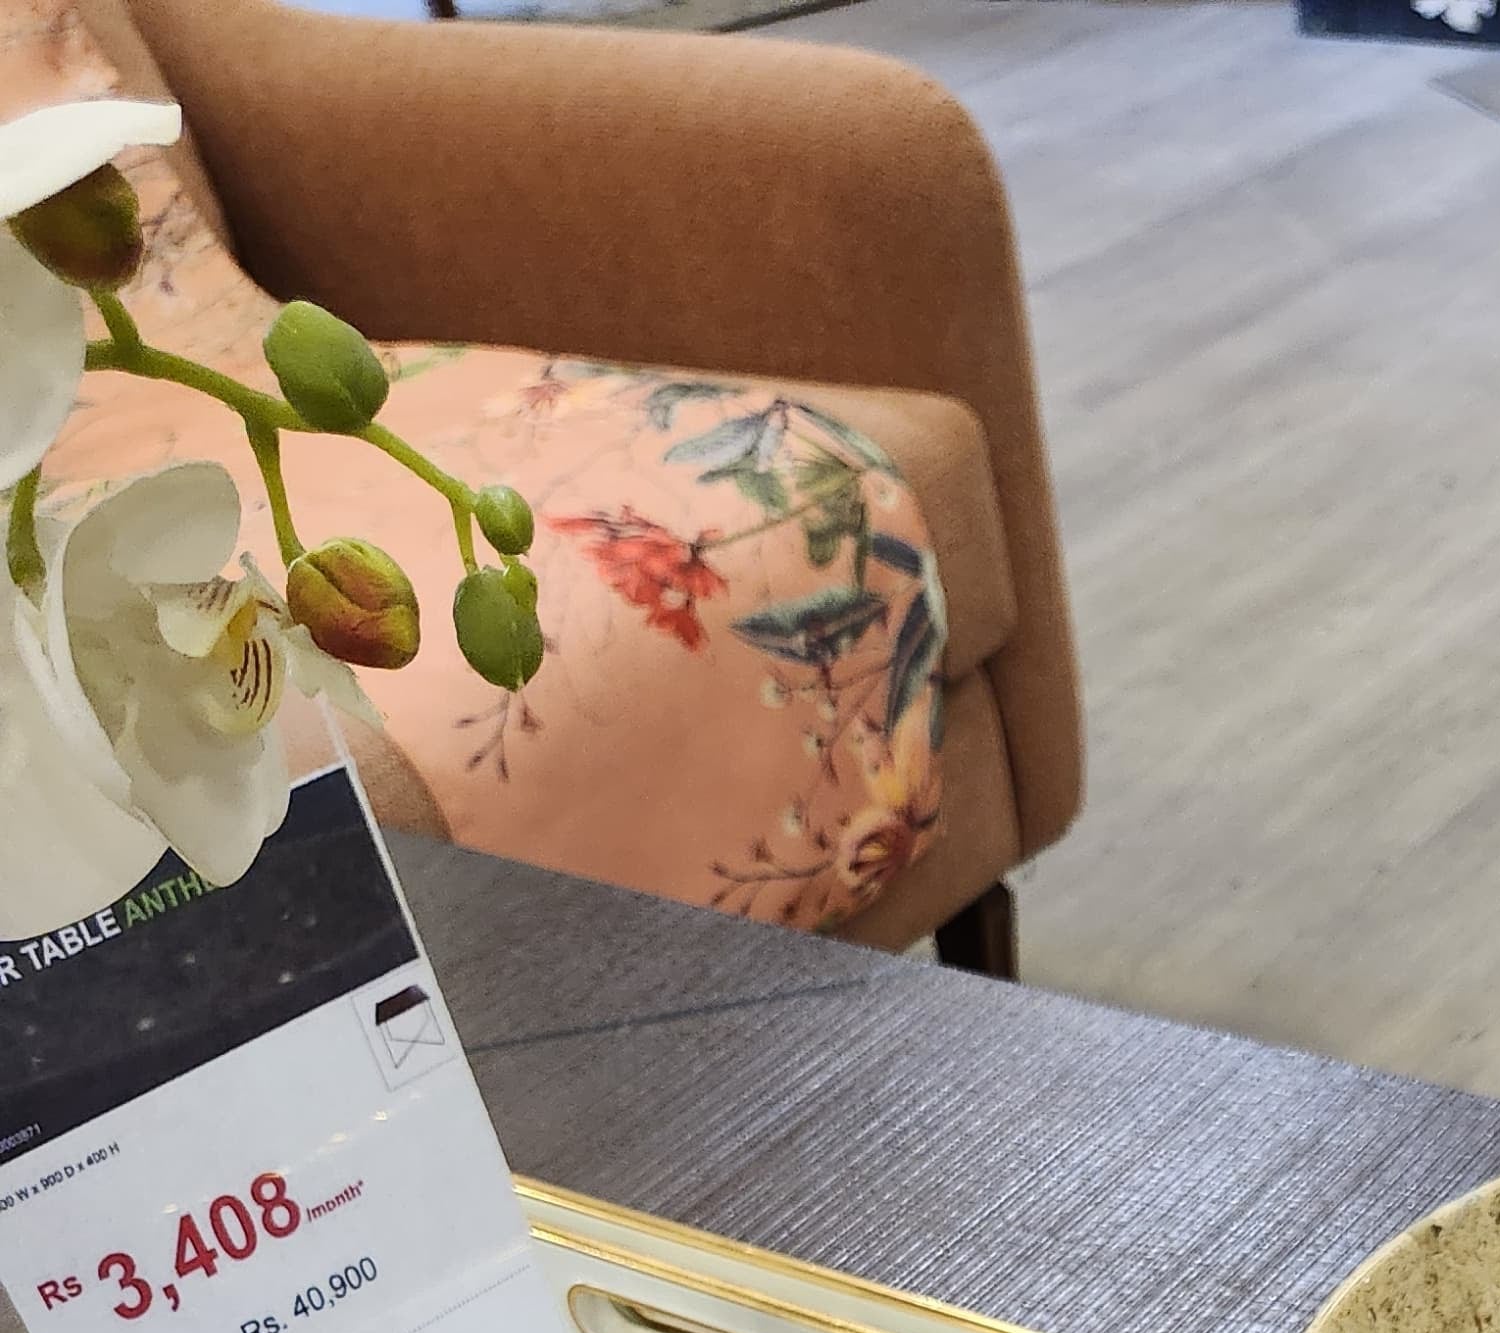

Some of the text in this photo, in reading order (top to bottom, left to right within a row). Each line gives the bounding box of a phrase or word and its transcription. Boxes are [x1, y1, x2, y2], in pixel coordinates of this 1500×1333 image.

[19, 907, 123, 971] TABLE
[15, 1187, 29, 1202] W
[63, 1165, 75, 1179] D
[109, 1141, 120, 1155] H
[37, 1276, 83, 1310] Rs
[97, 1173, 301, 1320] 3,408
[292, 1257, 378, 1320] 40,900
